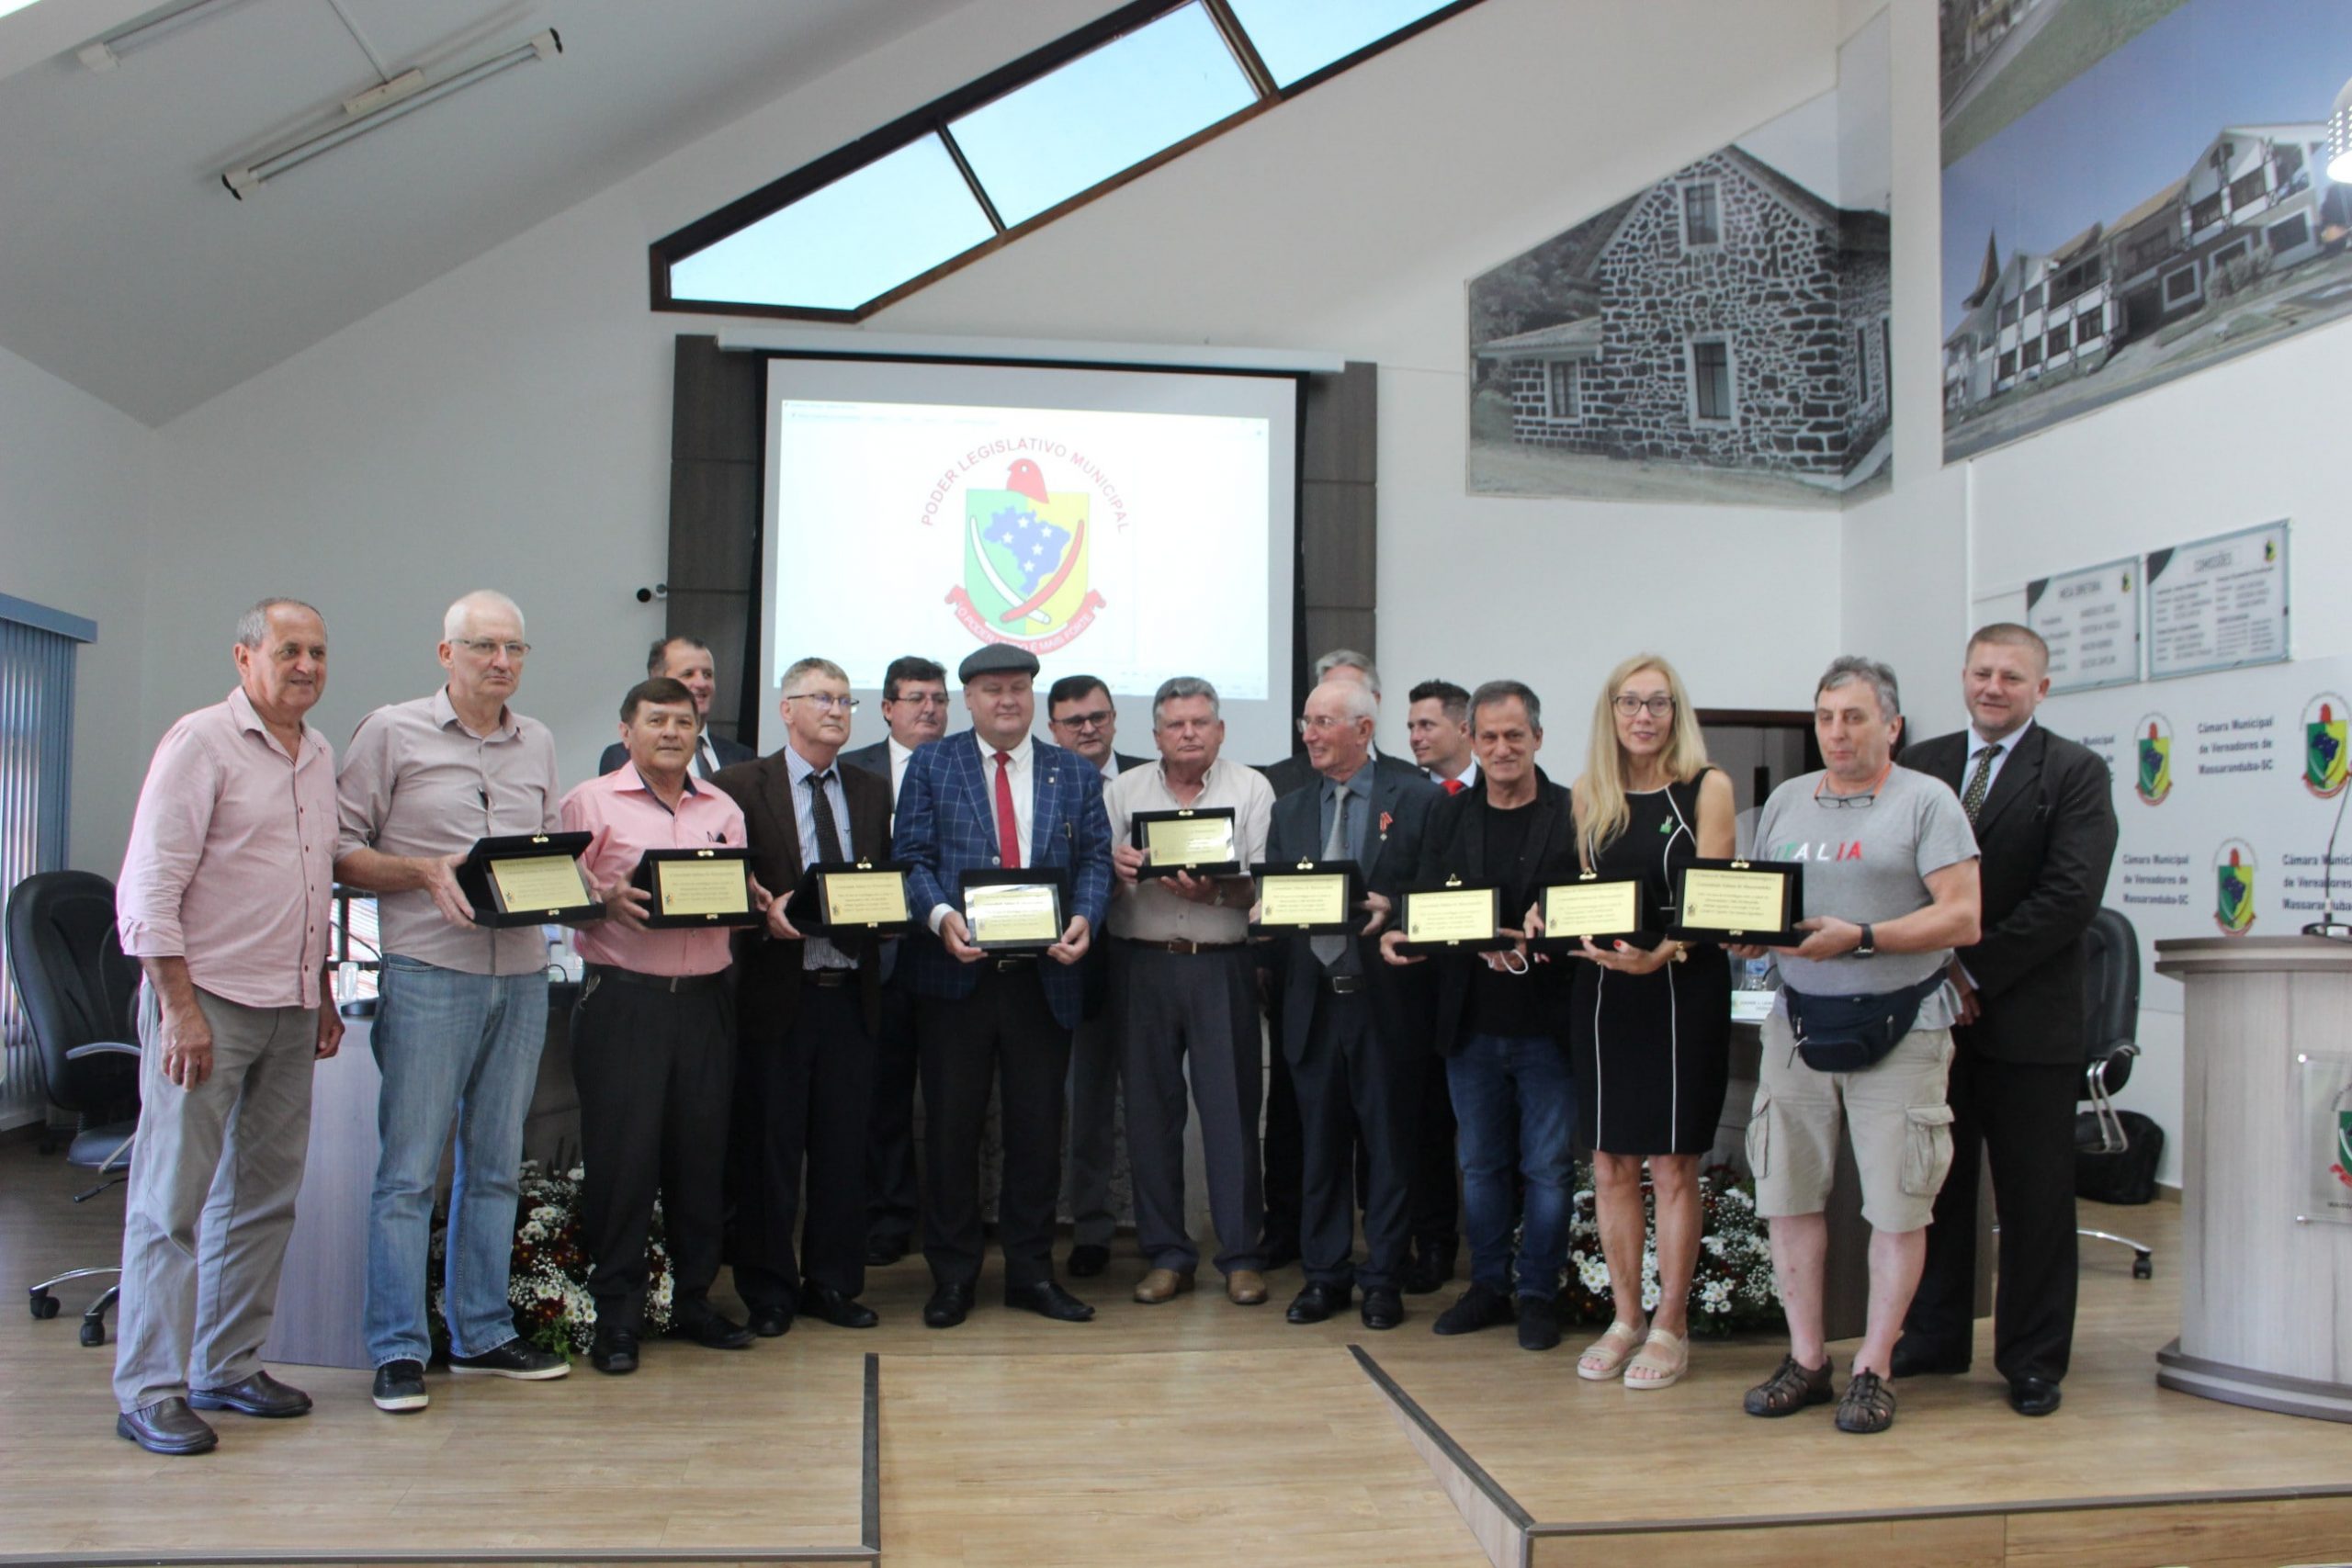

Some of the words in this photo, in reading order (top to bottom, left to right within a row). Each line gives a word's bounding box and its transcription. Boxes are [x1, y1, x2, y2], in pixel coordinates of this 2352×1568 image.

[921, 469, 959, 526] PODER
[958, 437, 1067, 471] LEGISLATIVO
[1070, 452, 1130, 534] MUNICIPAL
[2232, 716, 2273, 730] Municipal
[2211, 741, 2258, 752] Vereadores
[2262, 739, 2272, 749] de
[1775, 841, 1862, 862] ITALIA
[2153, 854, 2188, 865] Municipal
